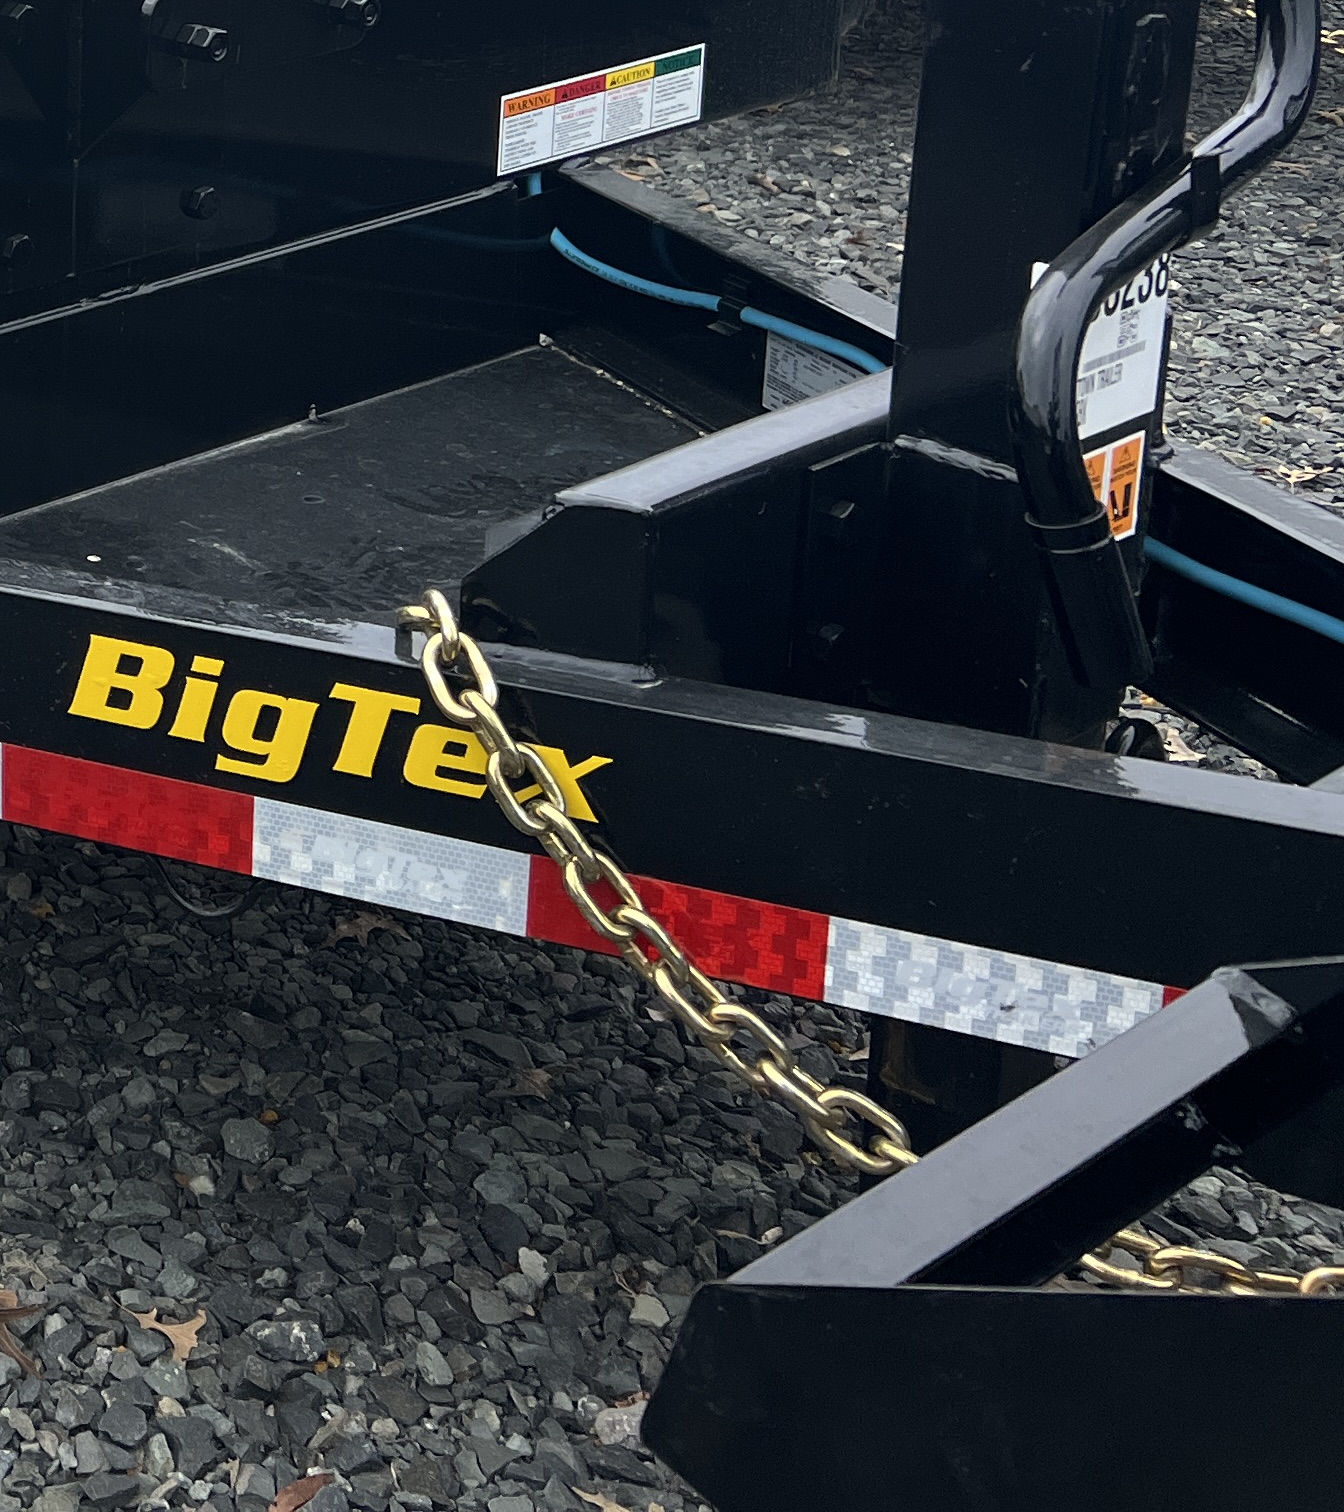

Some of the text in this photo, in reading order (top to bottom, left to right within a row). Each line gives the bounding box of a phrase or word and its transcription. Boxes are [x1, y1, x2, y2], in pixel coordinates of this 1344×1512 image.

[616, 67, 652, 85] CAUTION
[569, 81, 602, 96] DANGER
[507, 92, 552, 113] WARNING
[67, 634, 613, 824] BigTex
